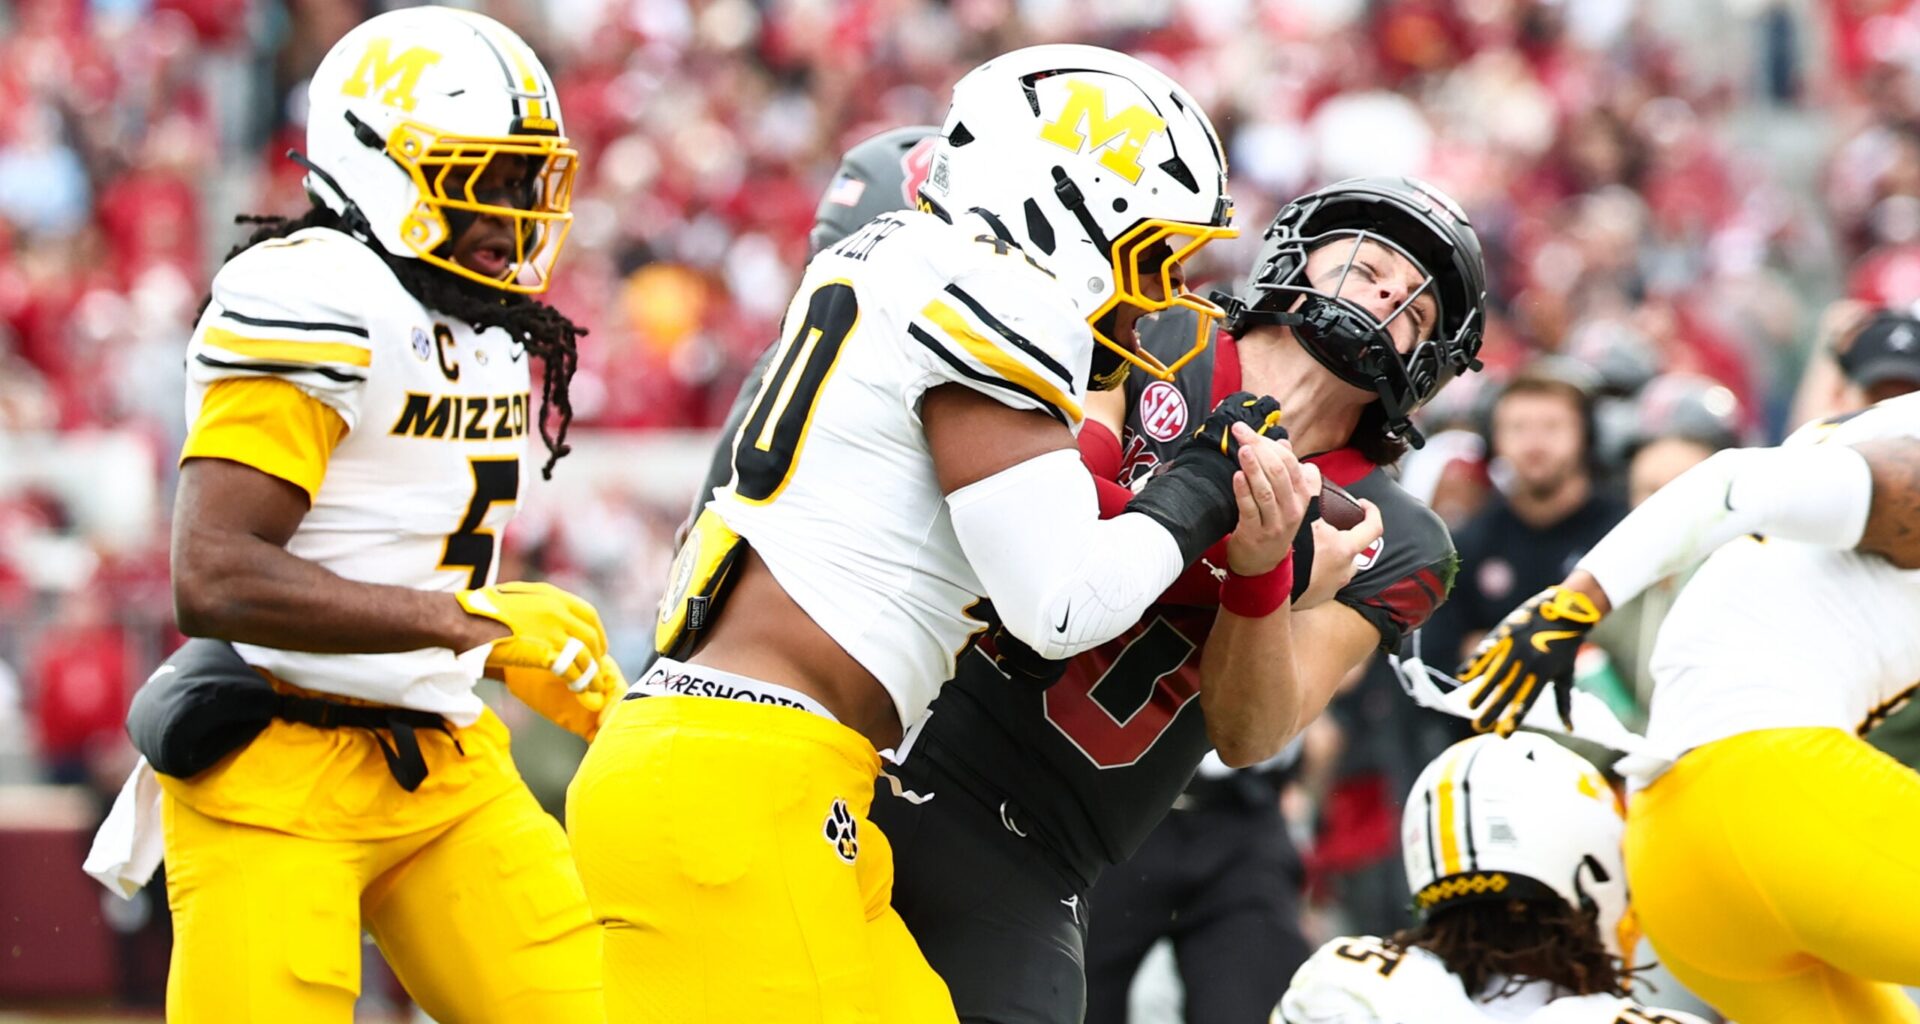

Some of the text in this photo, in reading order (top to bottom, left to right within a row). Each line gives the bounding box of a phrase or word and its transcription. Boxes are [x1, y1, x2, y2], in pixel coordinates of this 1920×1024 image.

[341, 36, 443, 113] M
[1038, 79, 1168, 186] M
[433, 320, 460, 383] C
[1143, 384, 1185, 437] SEC
[435, 453, 520, 591] 5
